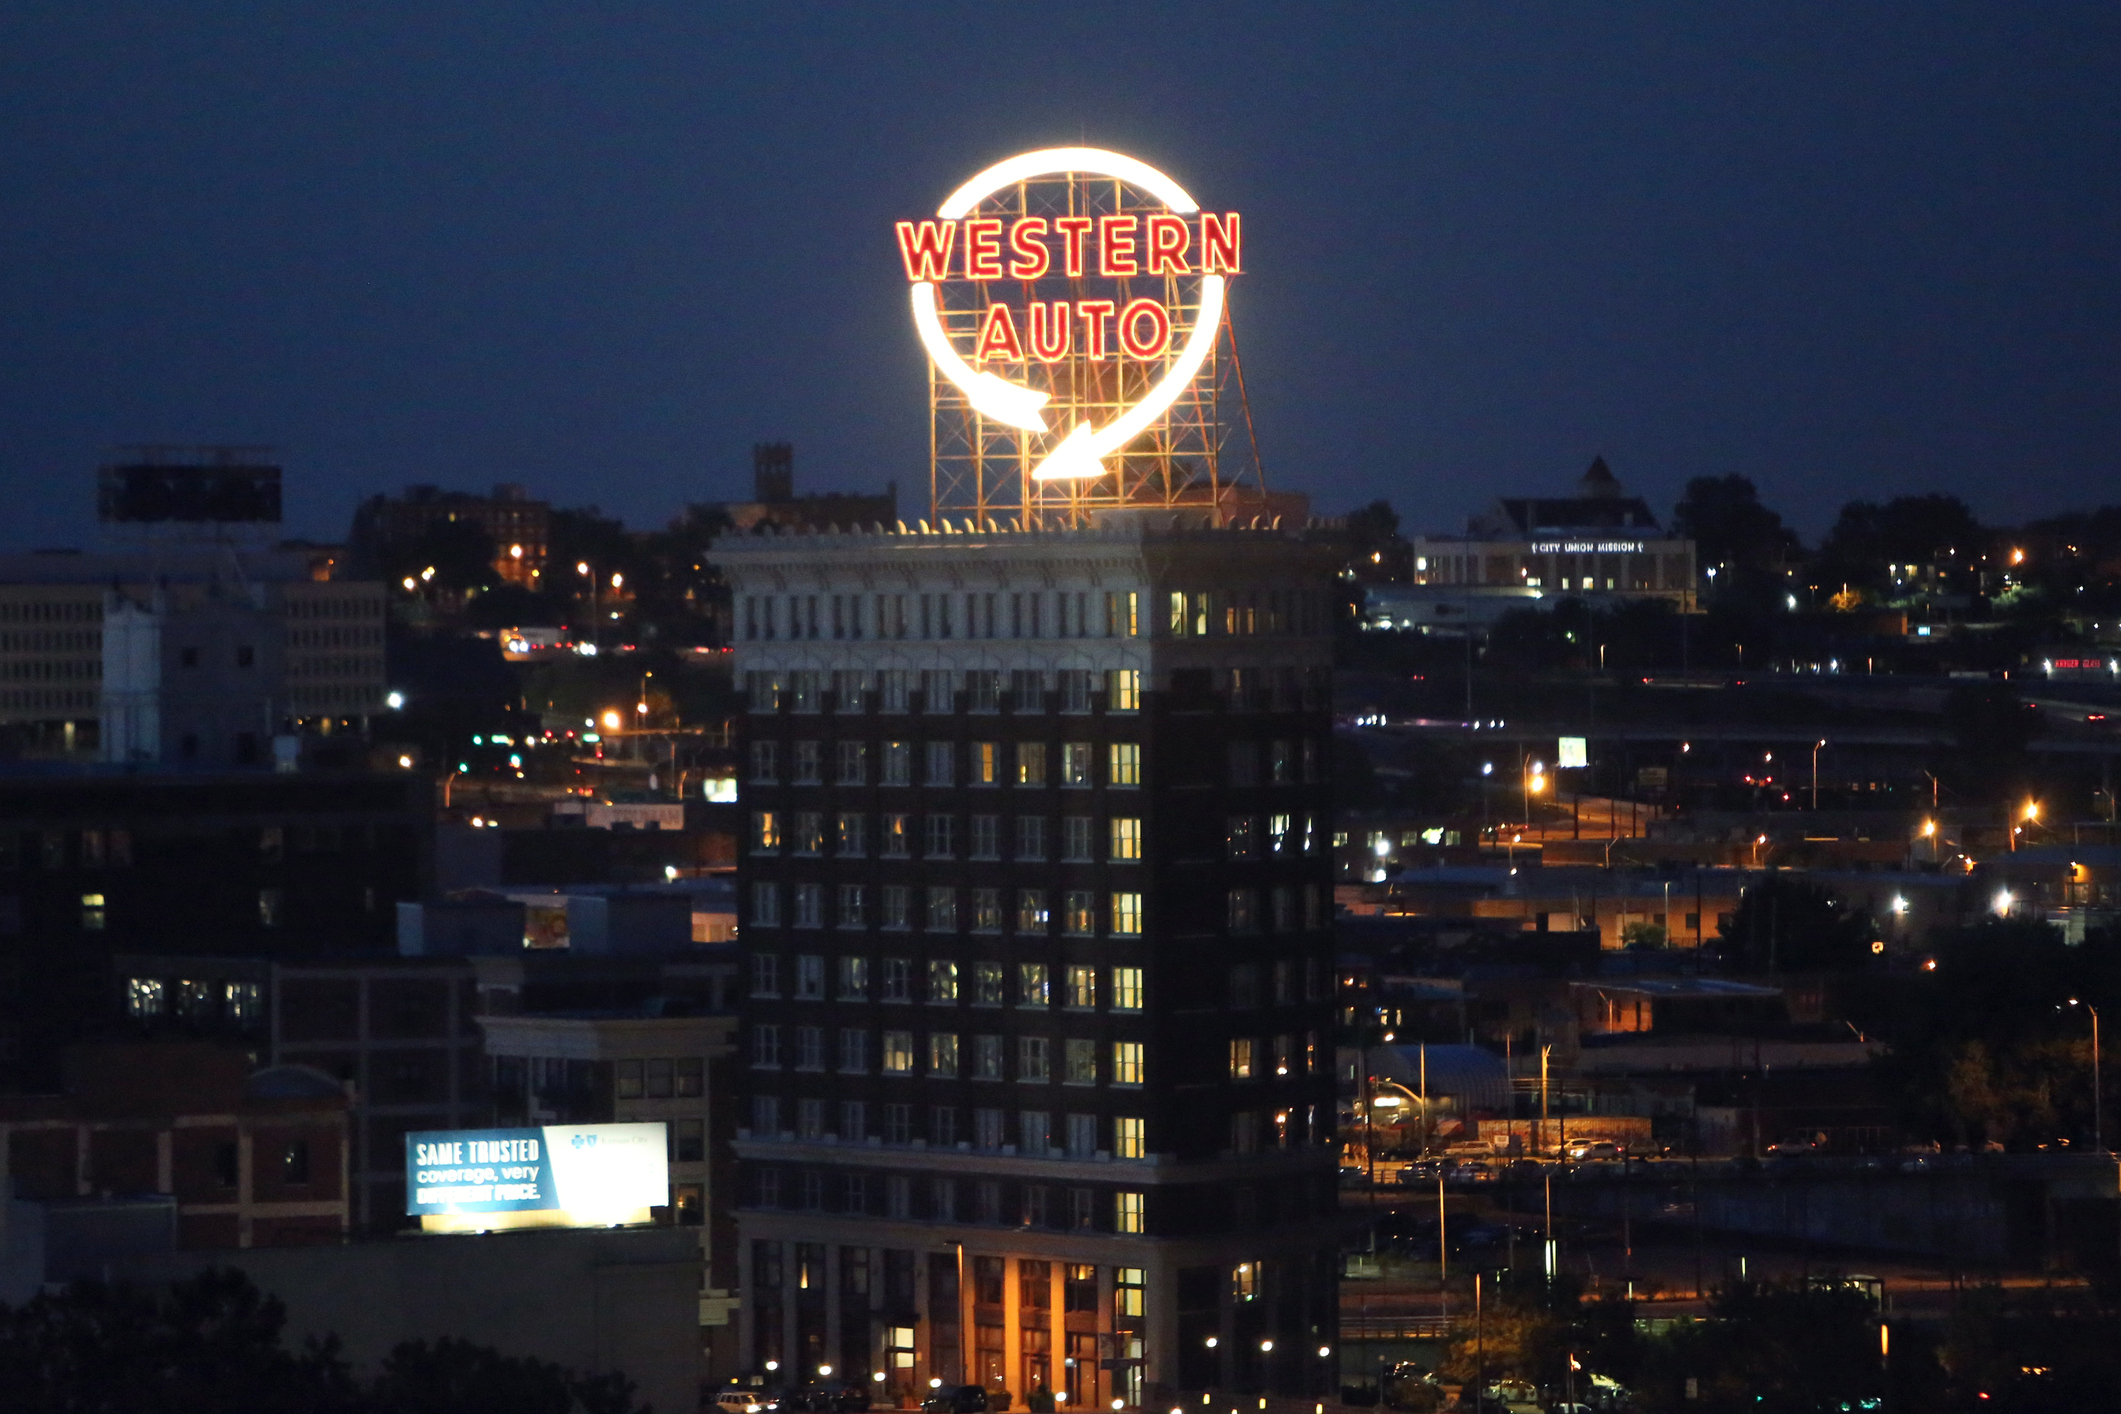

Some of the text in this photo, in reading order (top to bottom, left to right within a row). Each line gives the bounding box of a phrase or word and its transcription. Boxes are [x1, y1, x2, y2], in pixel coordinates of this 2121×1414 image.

[896, 212, 1241, 281] WESTERN
[975, 298, 1172, 363] AUTO
[1539, 542, 1635, 552] CITY UNION MISSION
[416, 1139, 539, 1166] SAME TRUSTED
[416, 1166, 540, 1184] coverage, very
